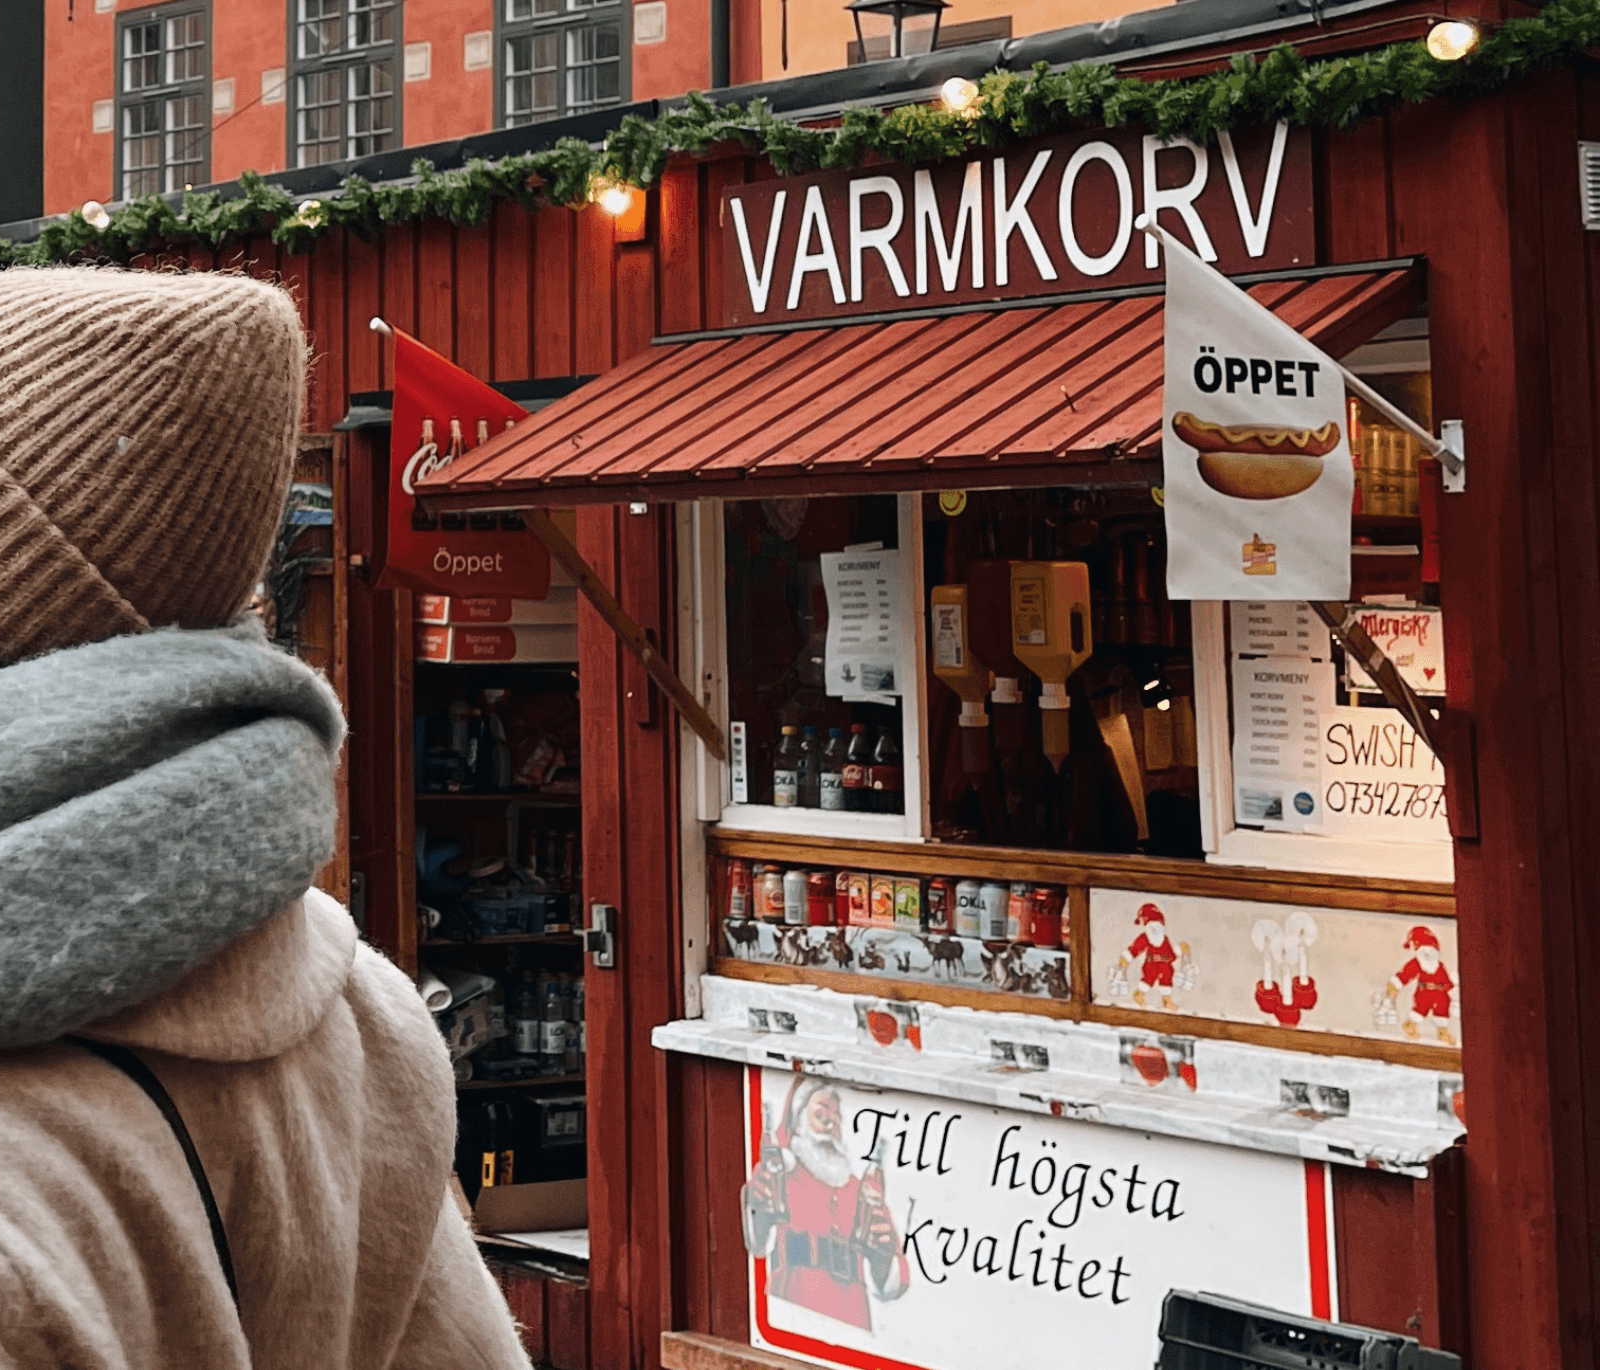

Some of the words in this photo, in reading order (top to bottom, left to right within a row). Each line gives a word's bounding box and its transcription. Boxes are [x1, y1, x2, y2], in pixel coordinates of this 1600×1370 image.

[729, 117, 1289, 313] VARMKORV
[1193, 346, 1320, 398] ÖPPET
[433, 547, 504, 578] Öppet
[1253, 672, 1310, 684] KORVMENY
[1326, 723, 1416, 769] SWISH
[853, 1108, 962, 1175] Till
[991, 1125, 1184, 1229] högsta
[902, 1197, 1131, 1305] kvalitet
